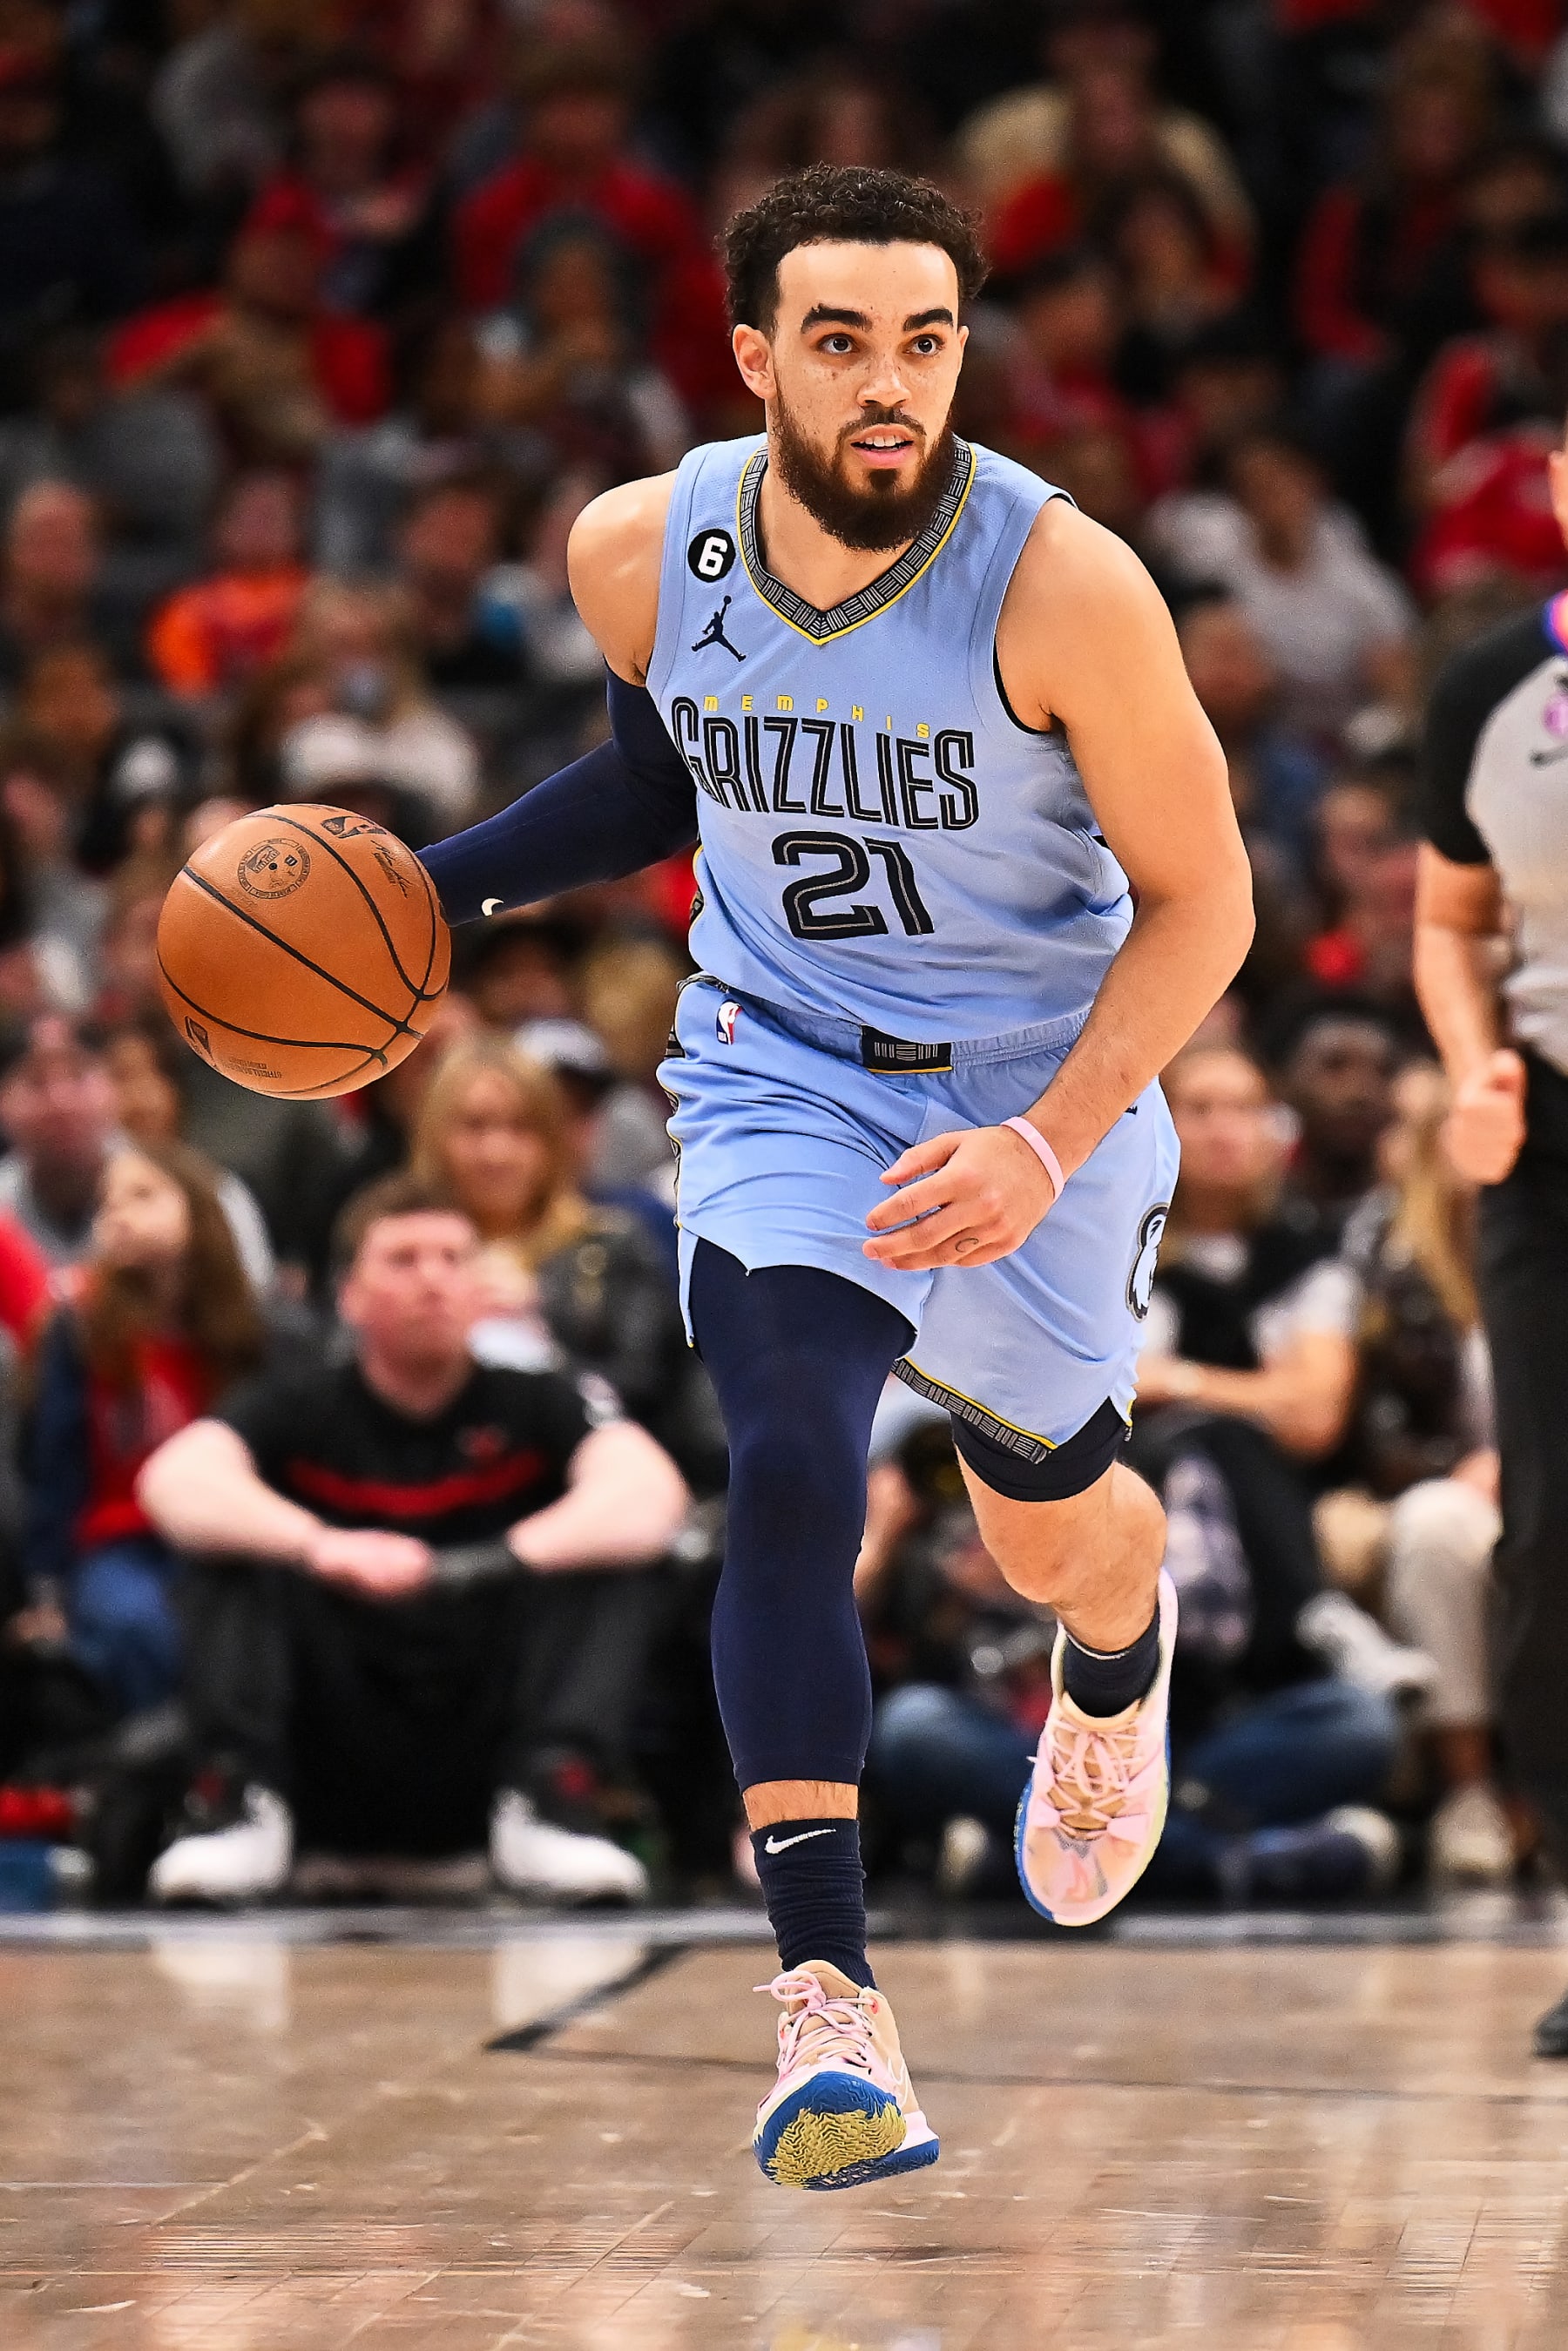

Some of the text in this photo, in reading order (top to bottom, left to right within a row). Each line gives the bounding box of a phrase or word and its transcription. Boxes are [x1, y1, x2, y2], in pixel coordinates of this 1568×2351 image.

[698, 537, 728, 576] 6
[703, 694, 930, 739] MEMPHIS
[671, 696, 979, 831] GRIZZLIES
[771, 830, 935, 940] 21
